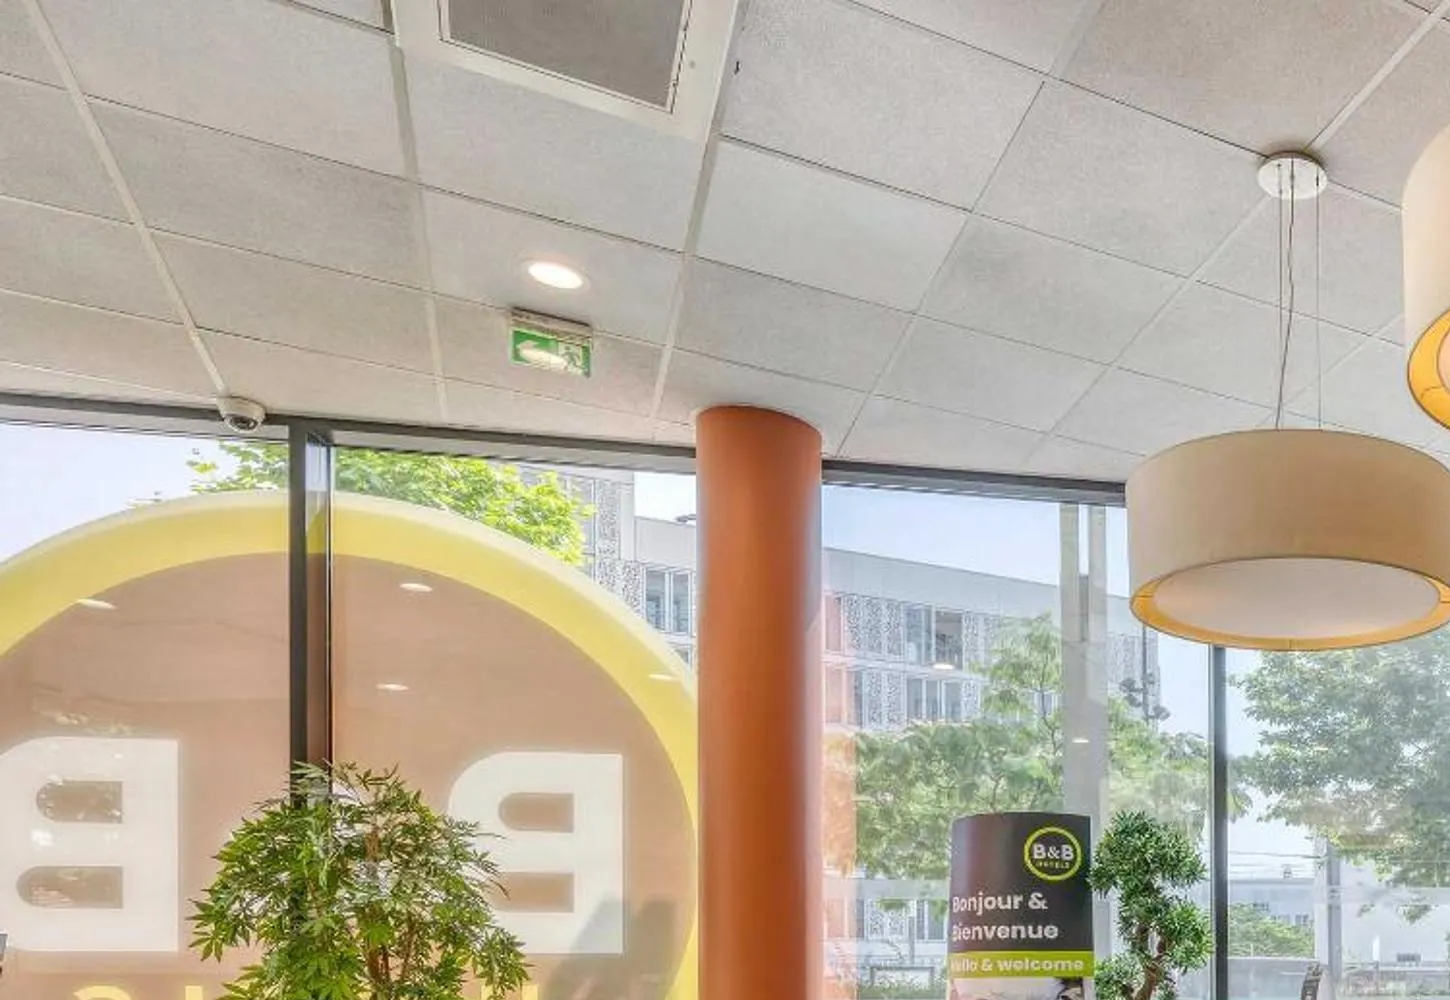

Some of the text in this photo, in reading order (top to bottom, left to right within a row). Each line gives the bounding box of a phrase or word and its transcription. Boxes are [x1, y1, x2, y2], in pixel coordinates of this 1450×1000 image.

[1032, 844, 1074, 861] B&B
[952, 891, 1049, 916] Bonjour &
[982, 958, 993, 972] &
[997, 957, 1085, 972] welcome
